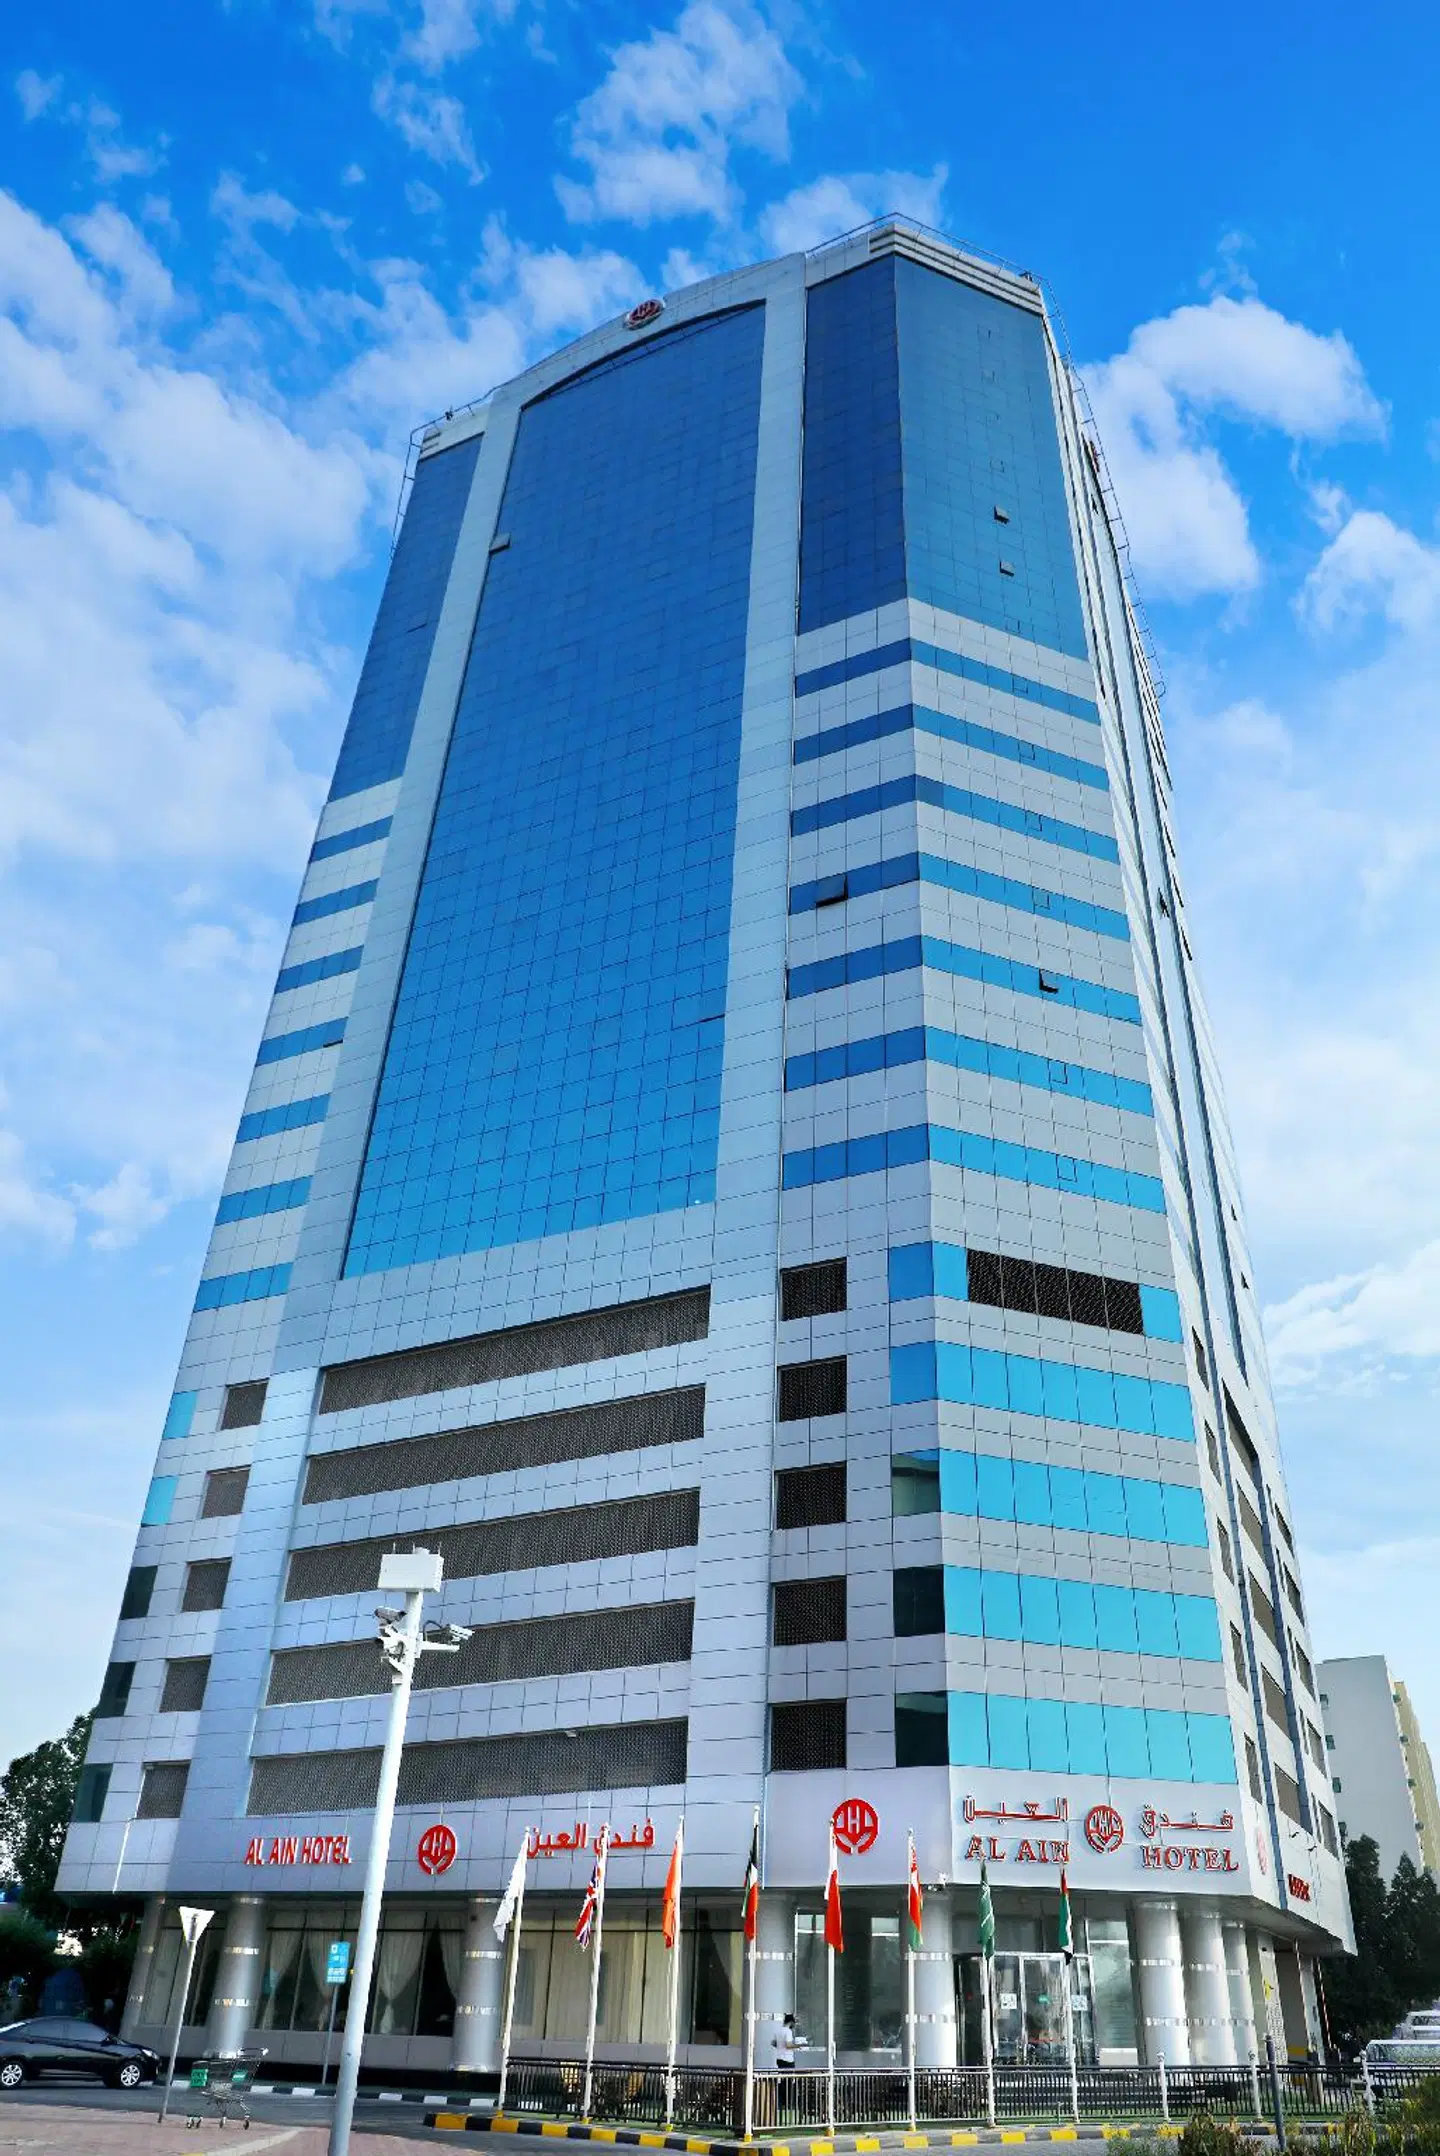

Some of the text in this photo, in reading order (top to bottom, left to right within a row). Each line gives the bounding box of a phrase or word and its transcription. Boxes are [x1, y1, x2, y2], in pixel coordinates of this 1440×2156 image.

[963, 1795, 1234, 1839] فندق العين
[244, 1835, 353, 1865] AL AIN HOTEL
[527, 1823, 588, 1859] العين
[965, 1834, 1239, 1872] AL AIN HOTEL
